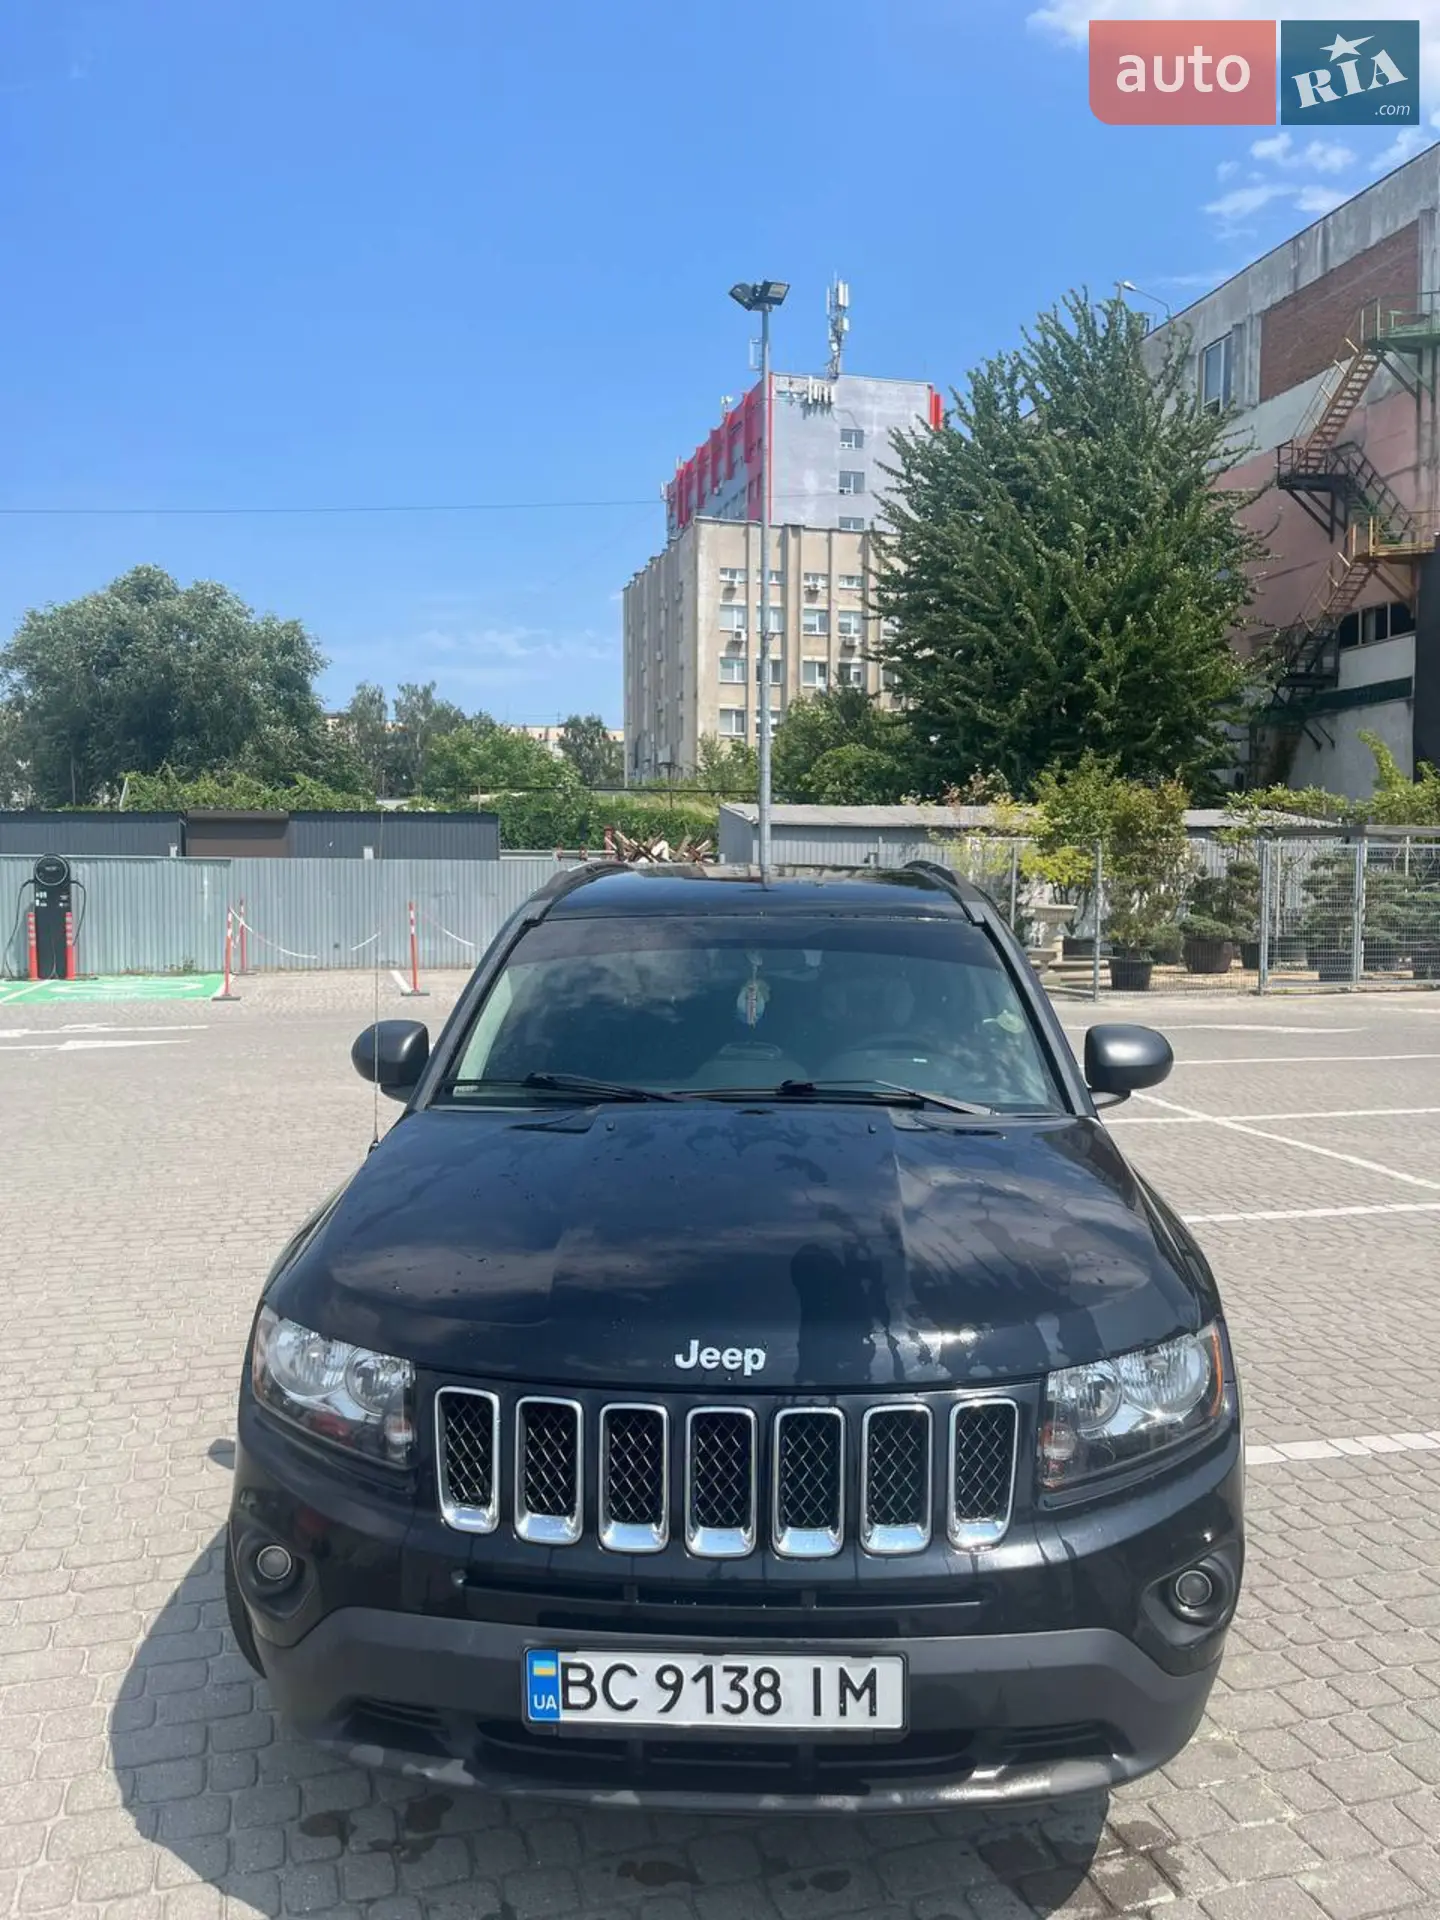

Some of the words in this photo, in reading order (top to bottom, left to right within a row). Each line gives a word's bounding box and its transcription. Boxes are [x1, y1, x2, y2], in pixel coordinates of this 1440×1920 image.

[674, 1339, 766, 1376] Jeep
[533, 1694, 557, 1710] UA
[560, 1661, 639, 1712] BC
[654, 1664, 783, 1716] 9138
[812, 1667, 877, 1717] IM
